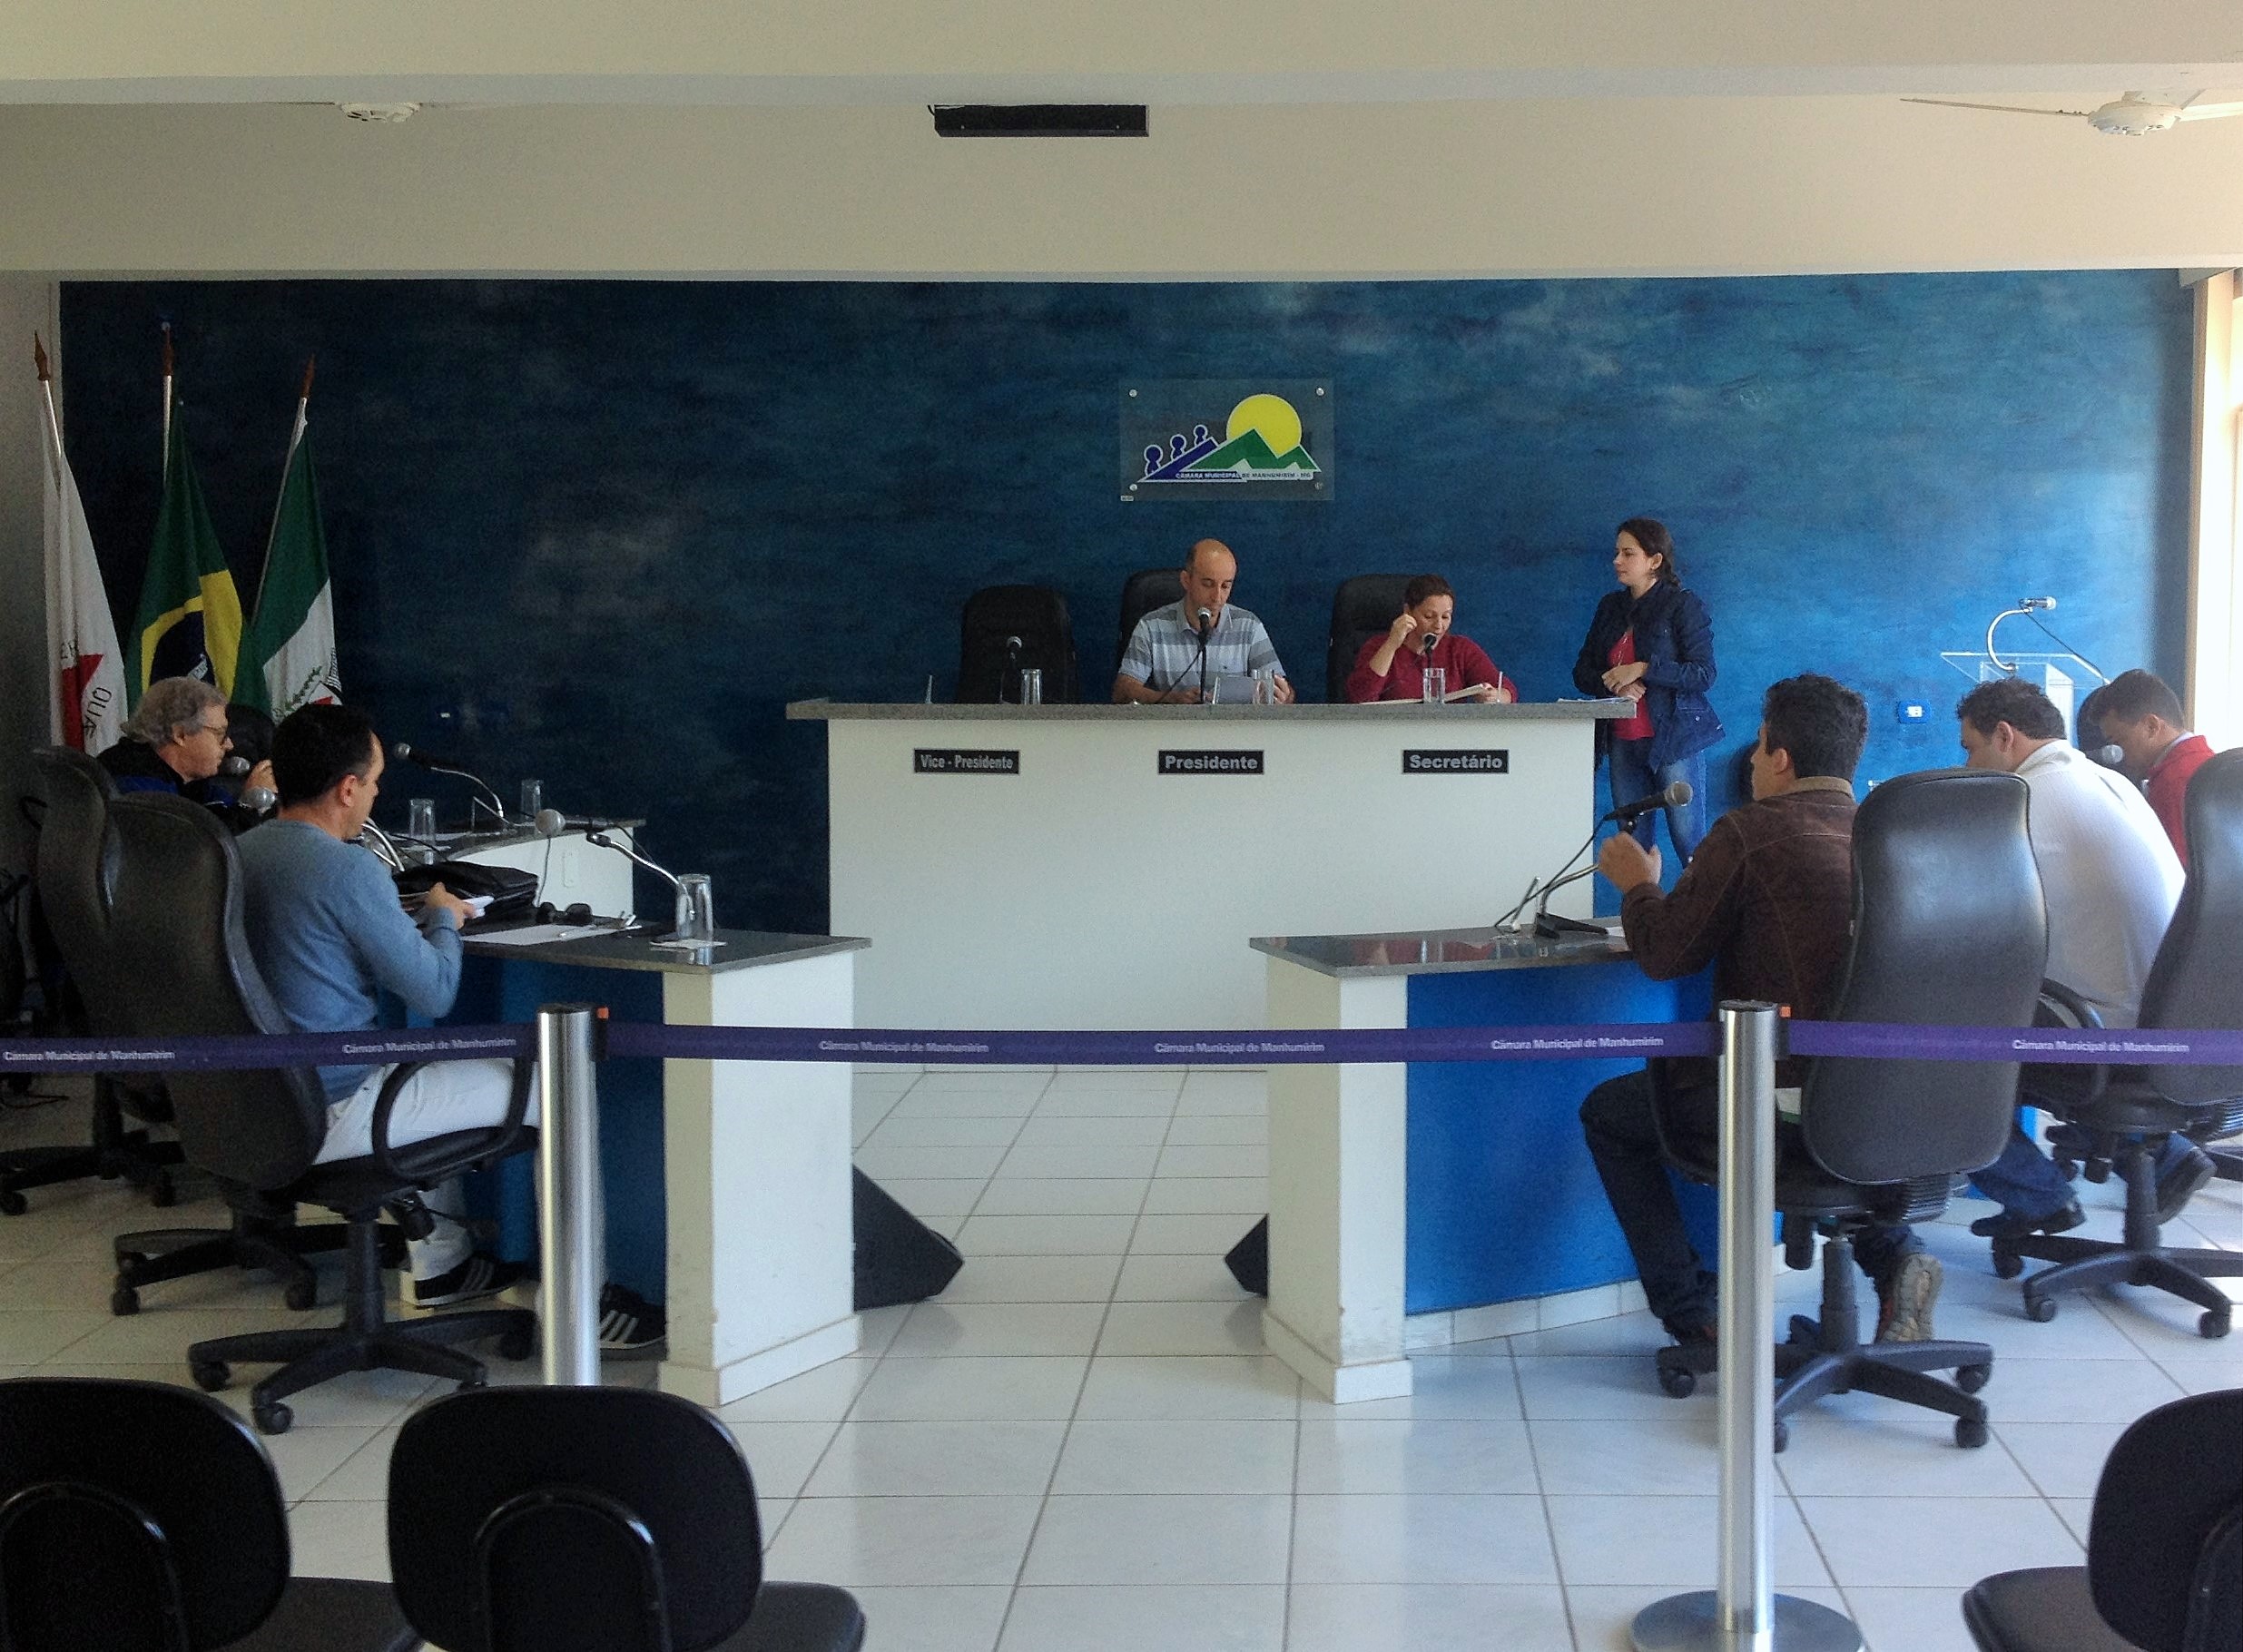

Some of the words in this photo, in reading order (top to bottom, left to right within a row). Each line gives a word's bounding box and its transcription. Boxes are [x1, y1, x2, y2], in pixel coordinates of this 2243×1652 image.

[920, 754, 945, 768] Vice
[954, 754, 1014, 769] Presidente
[1165, 755, 1258, 770] Presidente
[1409, 754, 1503, 769] Secretário
[385, 1041, 436, 1053] Municipal
[437, 1040, 449, 1050] de
[861, 1041, 910, 1053] Municipal
[910, 1043, 924, 1052] de
[1196, 1043, 1245, 1054] Municipal
[1246, 1042, 1259, 1052] de
[1490, 1039, 1532, 1050] Câmara
[1532, 1038, 1583, 1050] Municipal
[1583, 1037, 1598, 1047] de
[1599, 1037, 1665, 1047] Manhumirim
[2054, 1040, 2107, 1053] Municipal
[2108, 1041, 2122, 1051] de
[2123, 1042, 2190, 1053] Manhumirim
[95, 1050, 108, 1061] de
